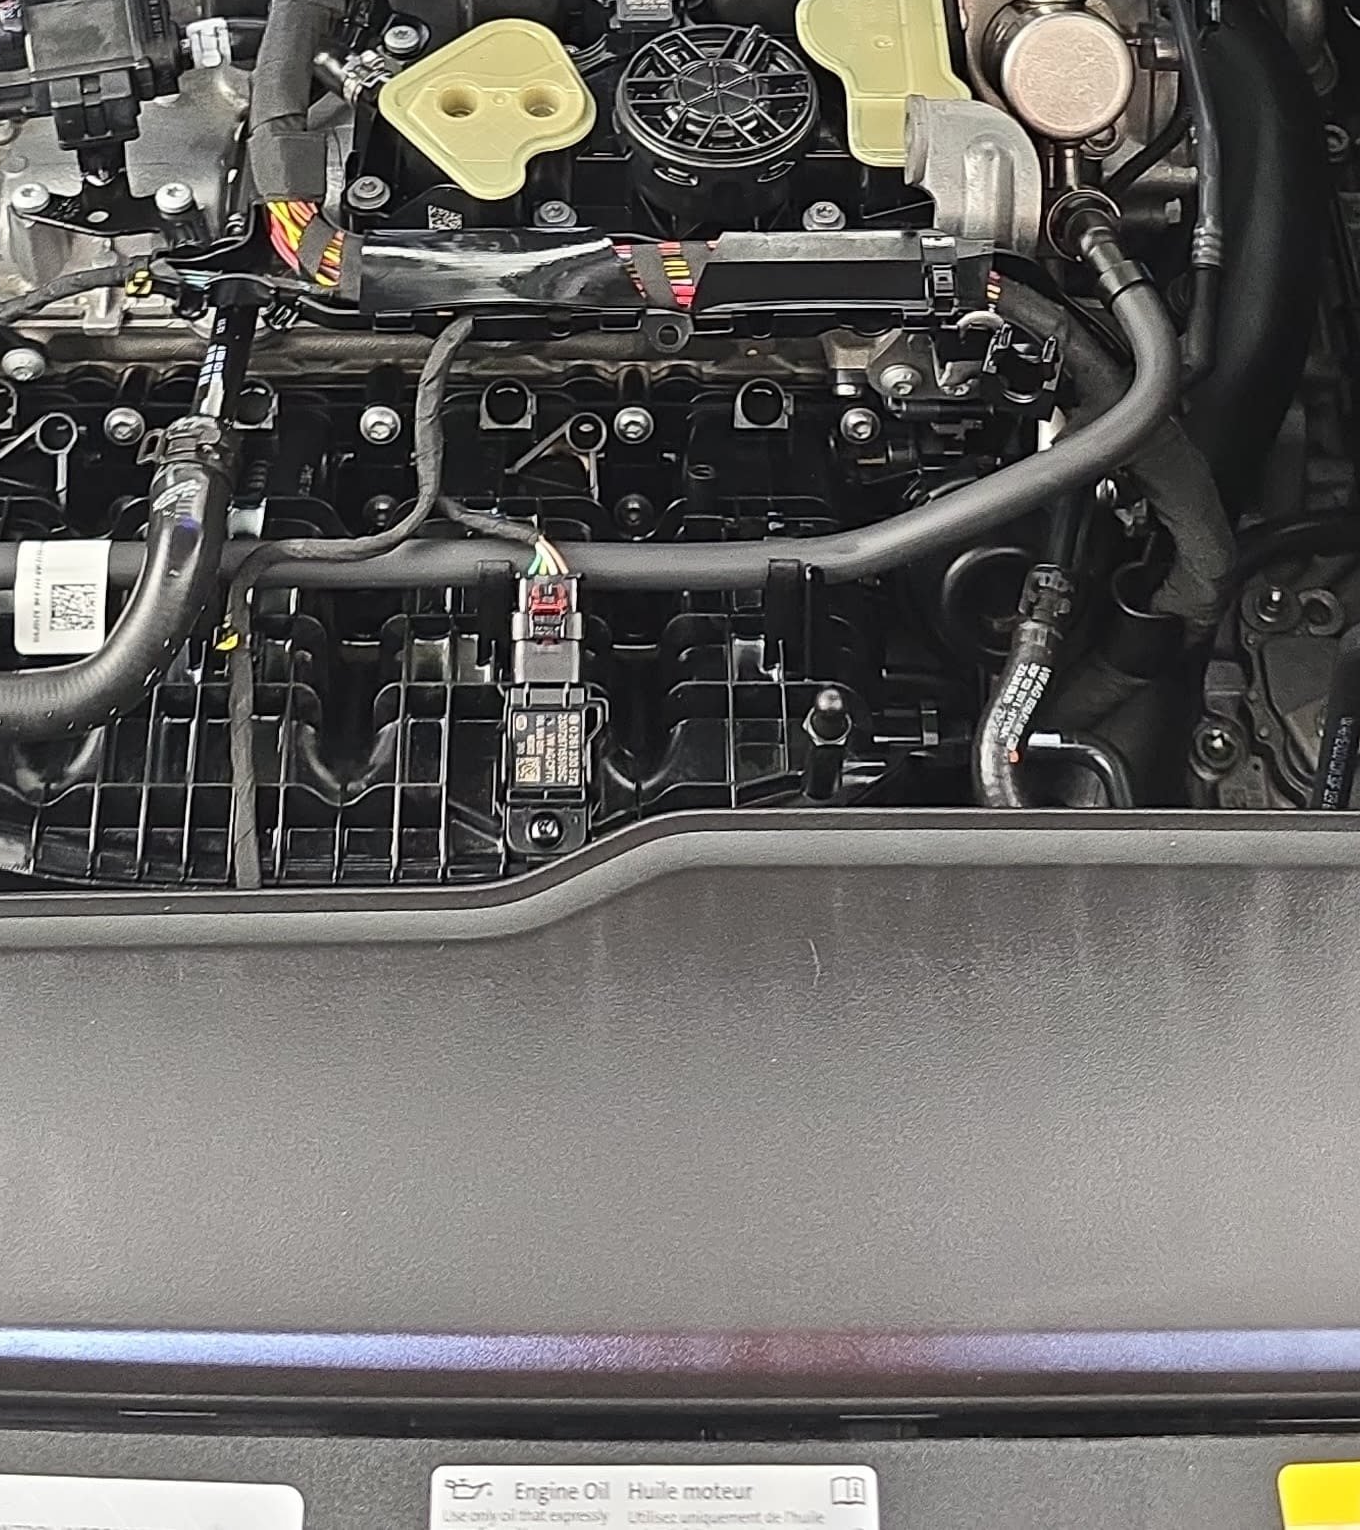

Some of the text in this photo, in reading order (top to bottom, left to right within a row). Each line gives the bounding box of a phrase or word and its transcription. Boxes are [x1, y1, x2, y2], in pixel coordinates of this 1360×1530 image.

[515, 1481, 611, 1506] Engine Oil
[627, 1480, 755, 1501] Huile moteur
